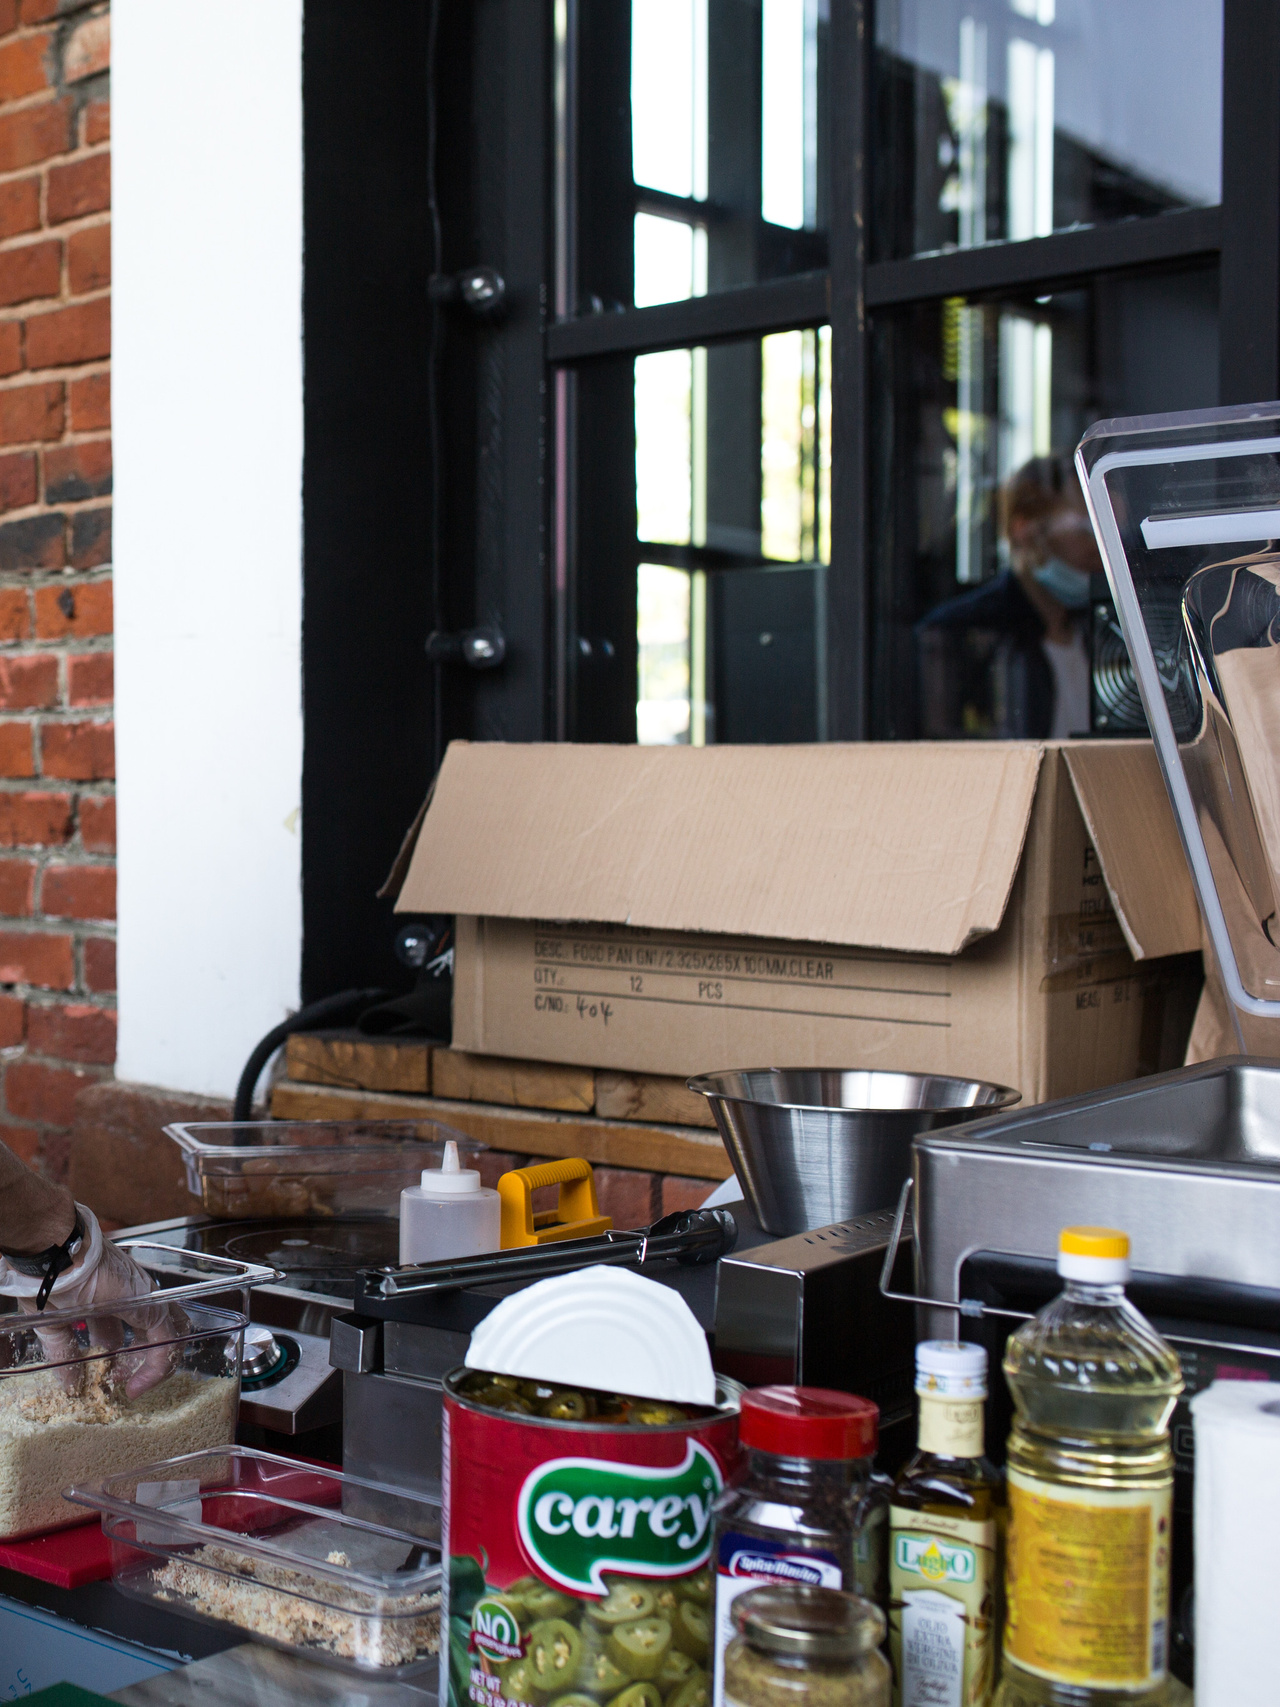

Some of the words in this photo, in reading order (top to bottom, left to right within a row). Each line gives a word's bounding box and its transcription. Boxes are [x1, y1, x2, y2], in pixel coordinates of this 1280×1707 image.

[608, 945, 632, 965] PAN
[630, 975, 643, 993] 12
[698, 981, 723, 1000] PCS
[534, 1490, 714, 1550] carey
[476, 1608, 511, 1646] NO
[470, 1668, 485, 1688] NET
[485, 1674, 501, 1692] WT
